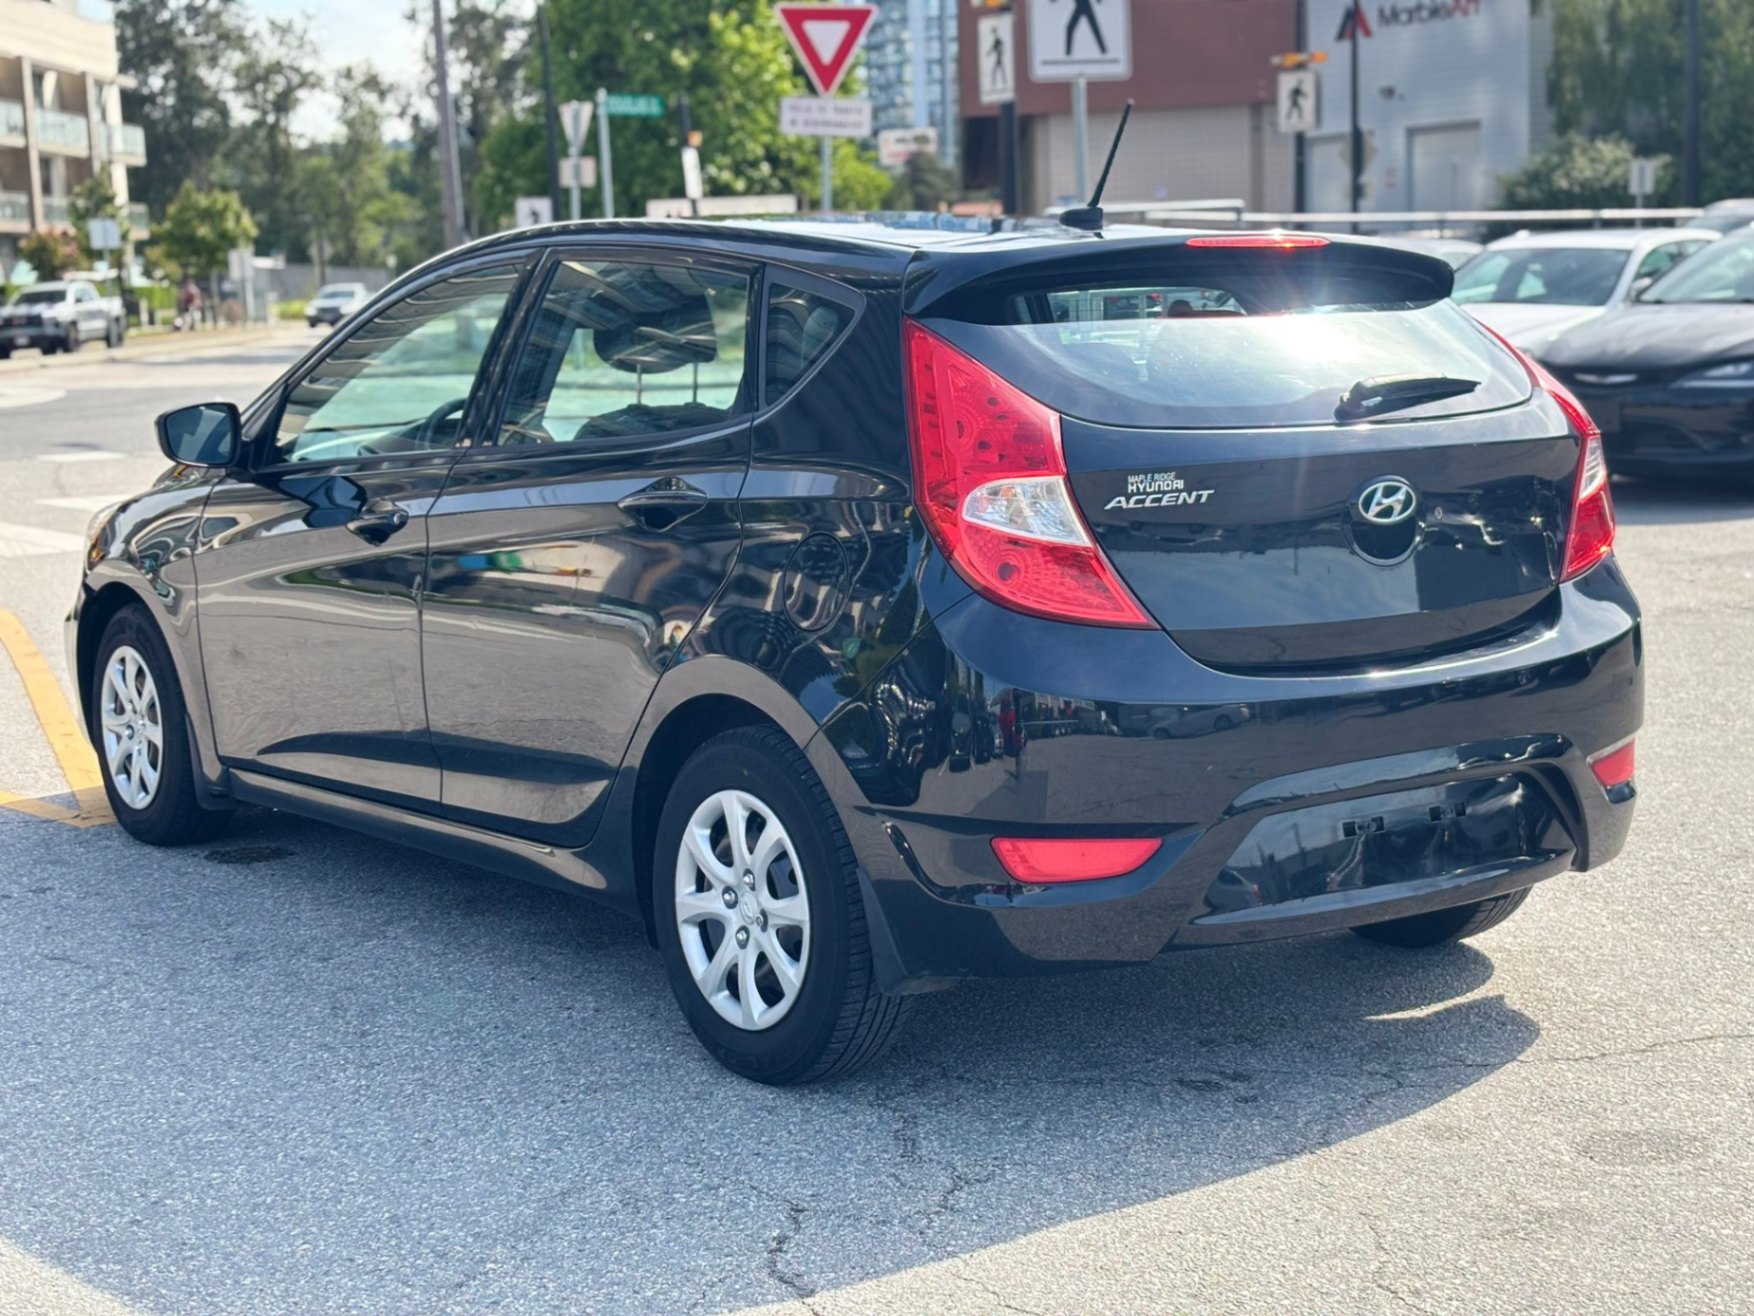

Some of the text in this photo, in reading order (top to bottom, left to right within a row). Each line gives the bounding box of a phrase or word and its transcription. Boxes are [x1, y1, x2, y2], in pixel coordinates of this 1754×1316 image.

[1128, 472, 1176, 483] MAPLE RIDGE
[1127, 479, 1185, 494] HYUNDAI
[1103, 489, 1215, 510] ACCENT
